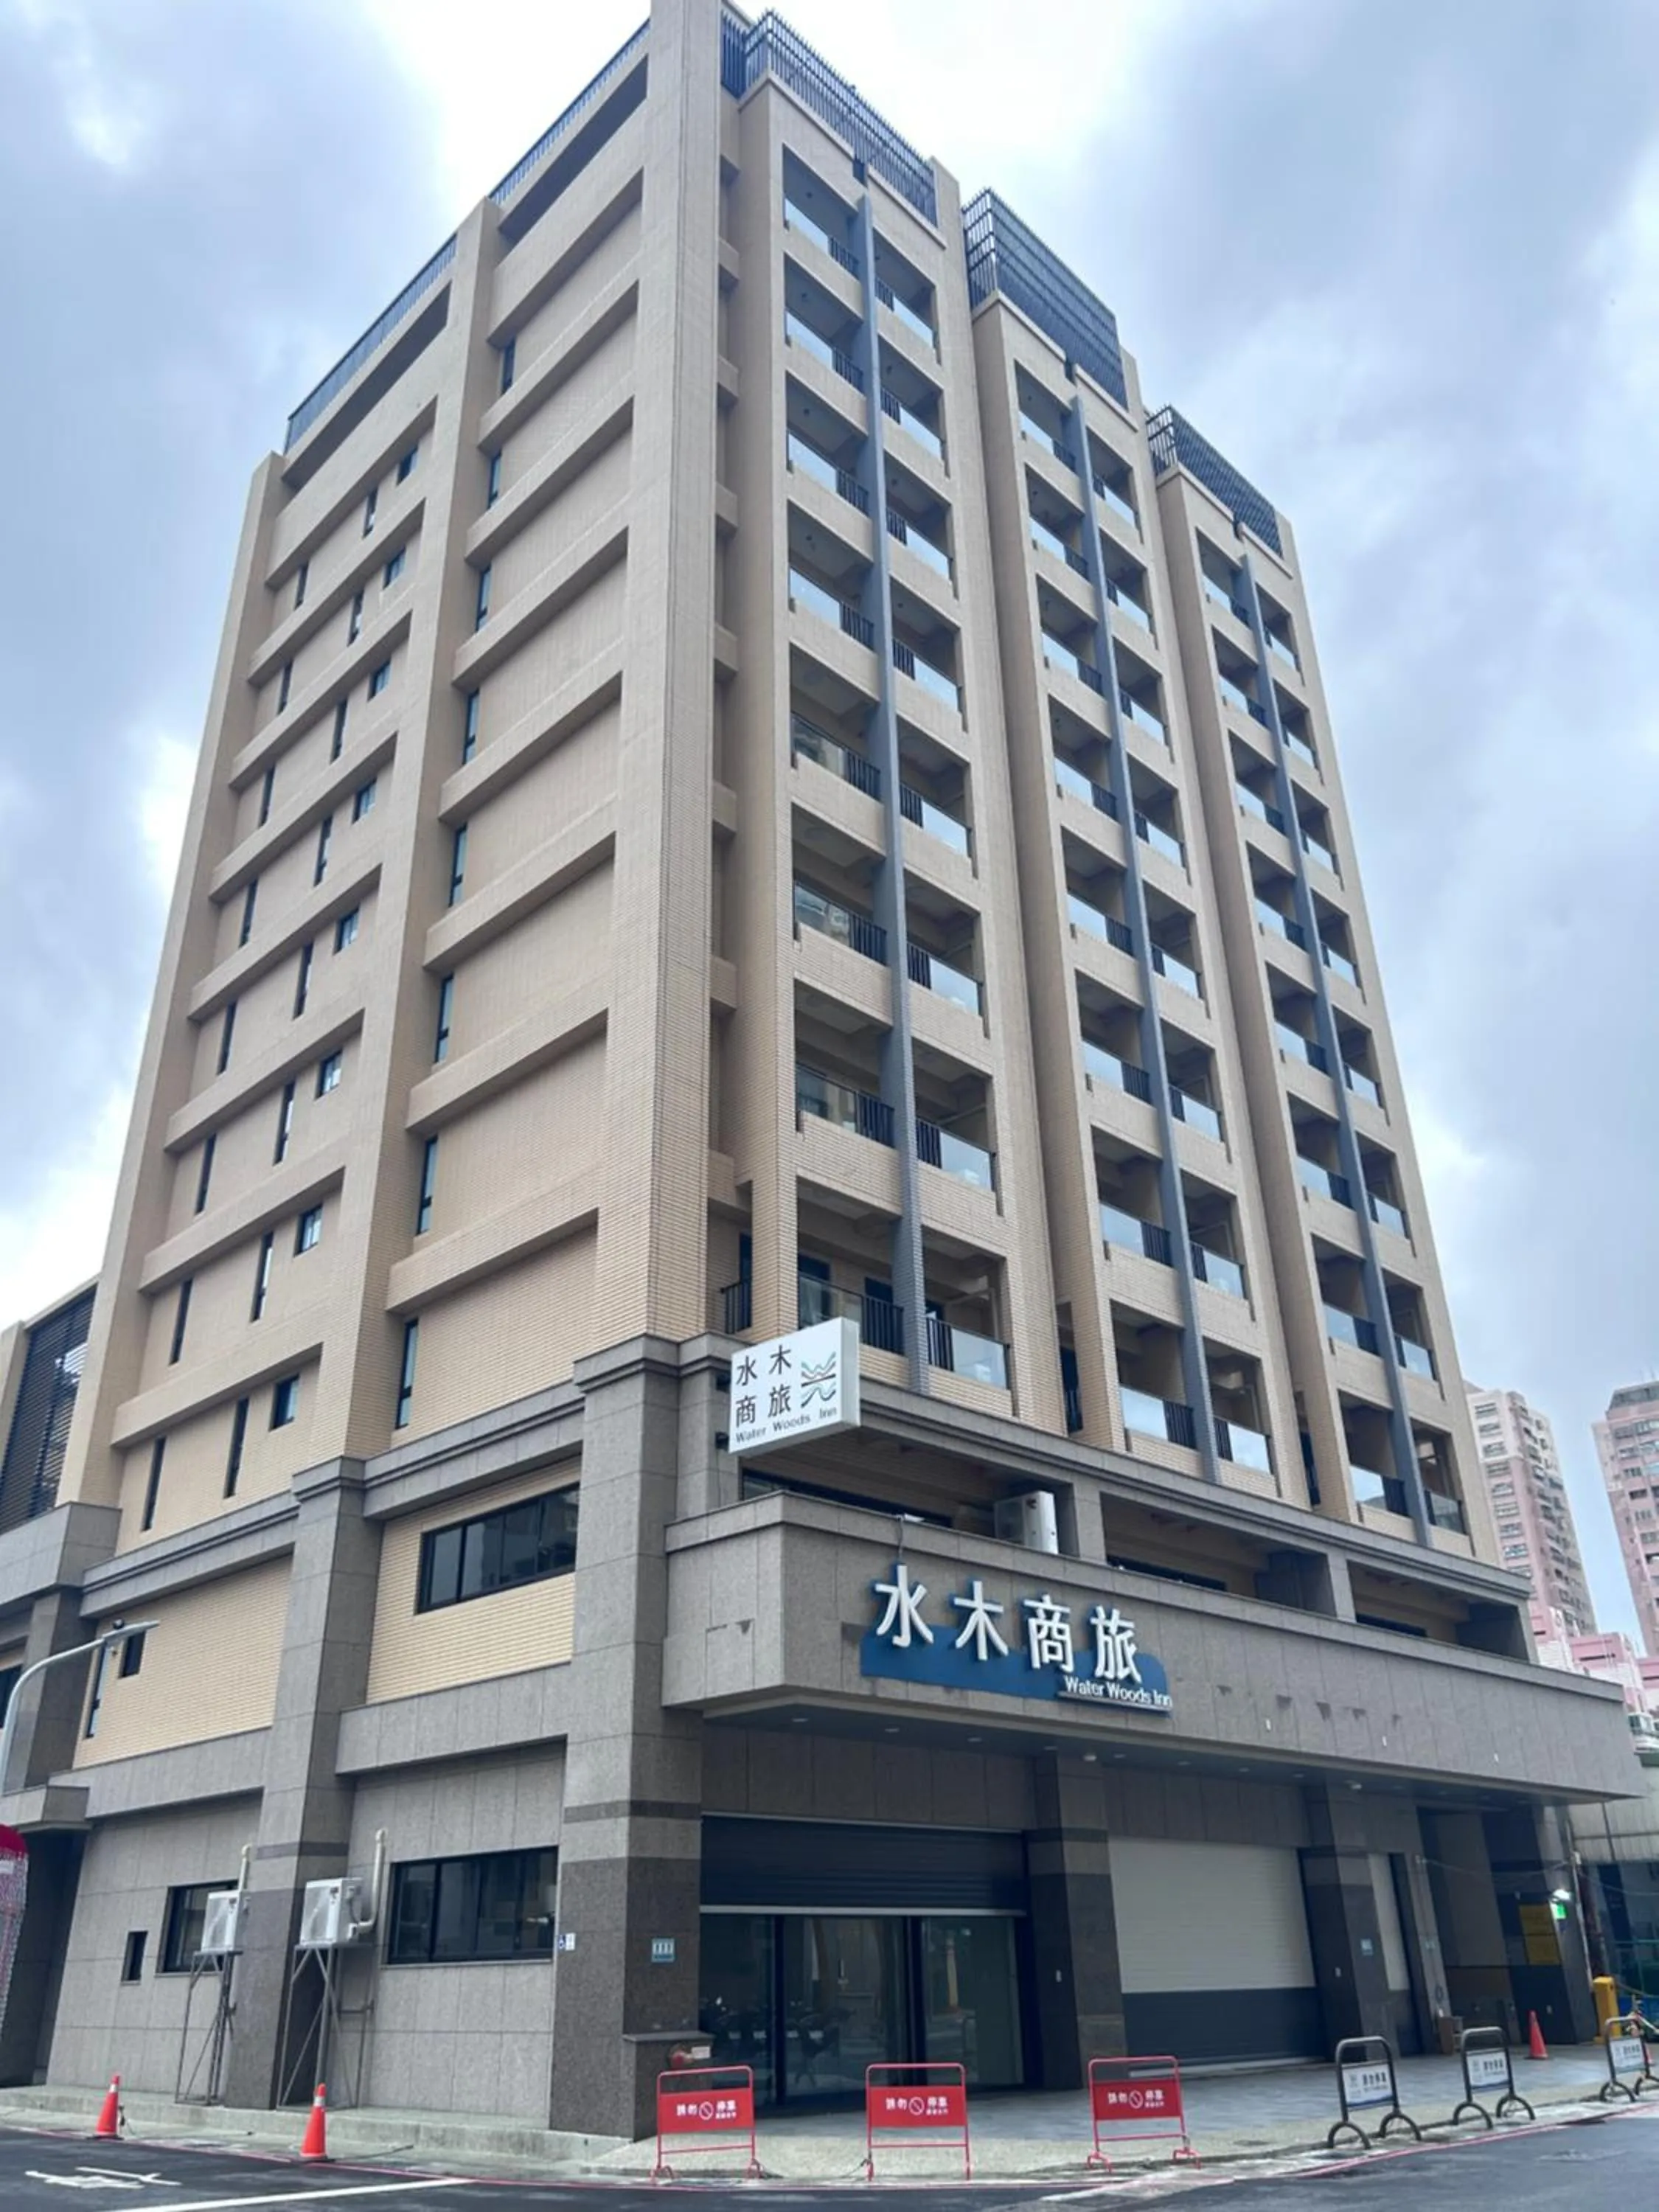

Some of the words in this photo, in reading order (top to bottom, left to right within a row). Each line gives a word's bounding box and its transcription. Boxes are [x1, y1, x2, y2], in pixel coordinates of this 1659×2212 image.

[736, 1344, 793, 1386] 水木
[735, 1384, 792, 1427] 商旅
[736, 1427, 767, 1443] Water
[773, 1414, 812, 1431] Woods
[819, 1407, 838, 1419] Inn
[874, 1565, 1142, 1683] 水木商旅
[1064, 1675, 1105, 1696] Water
[1106, 1681, 1152, 1705] Woods
[1152, 1689, 1174, 1708] Inn
